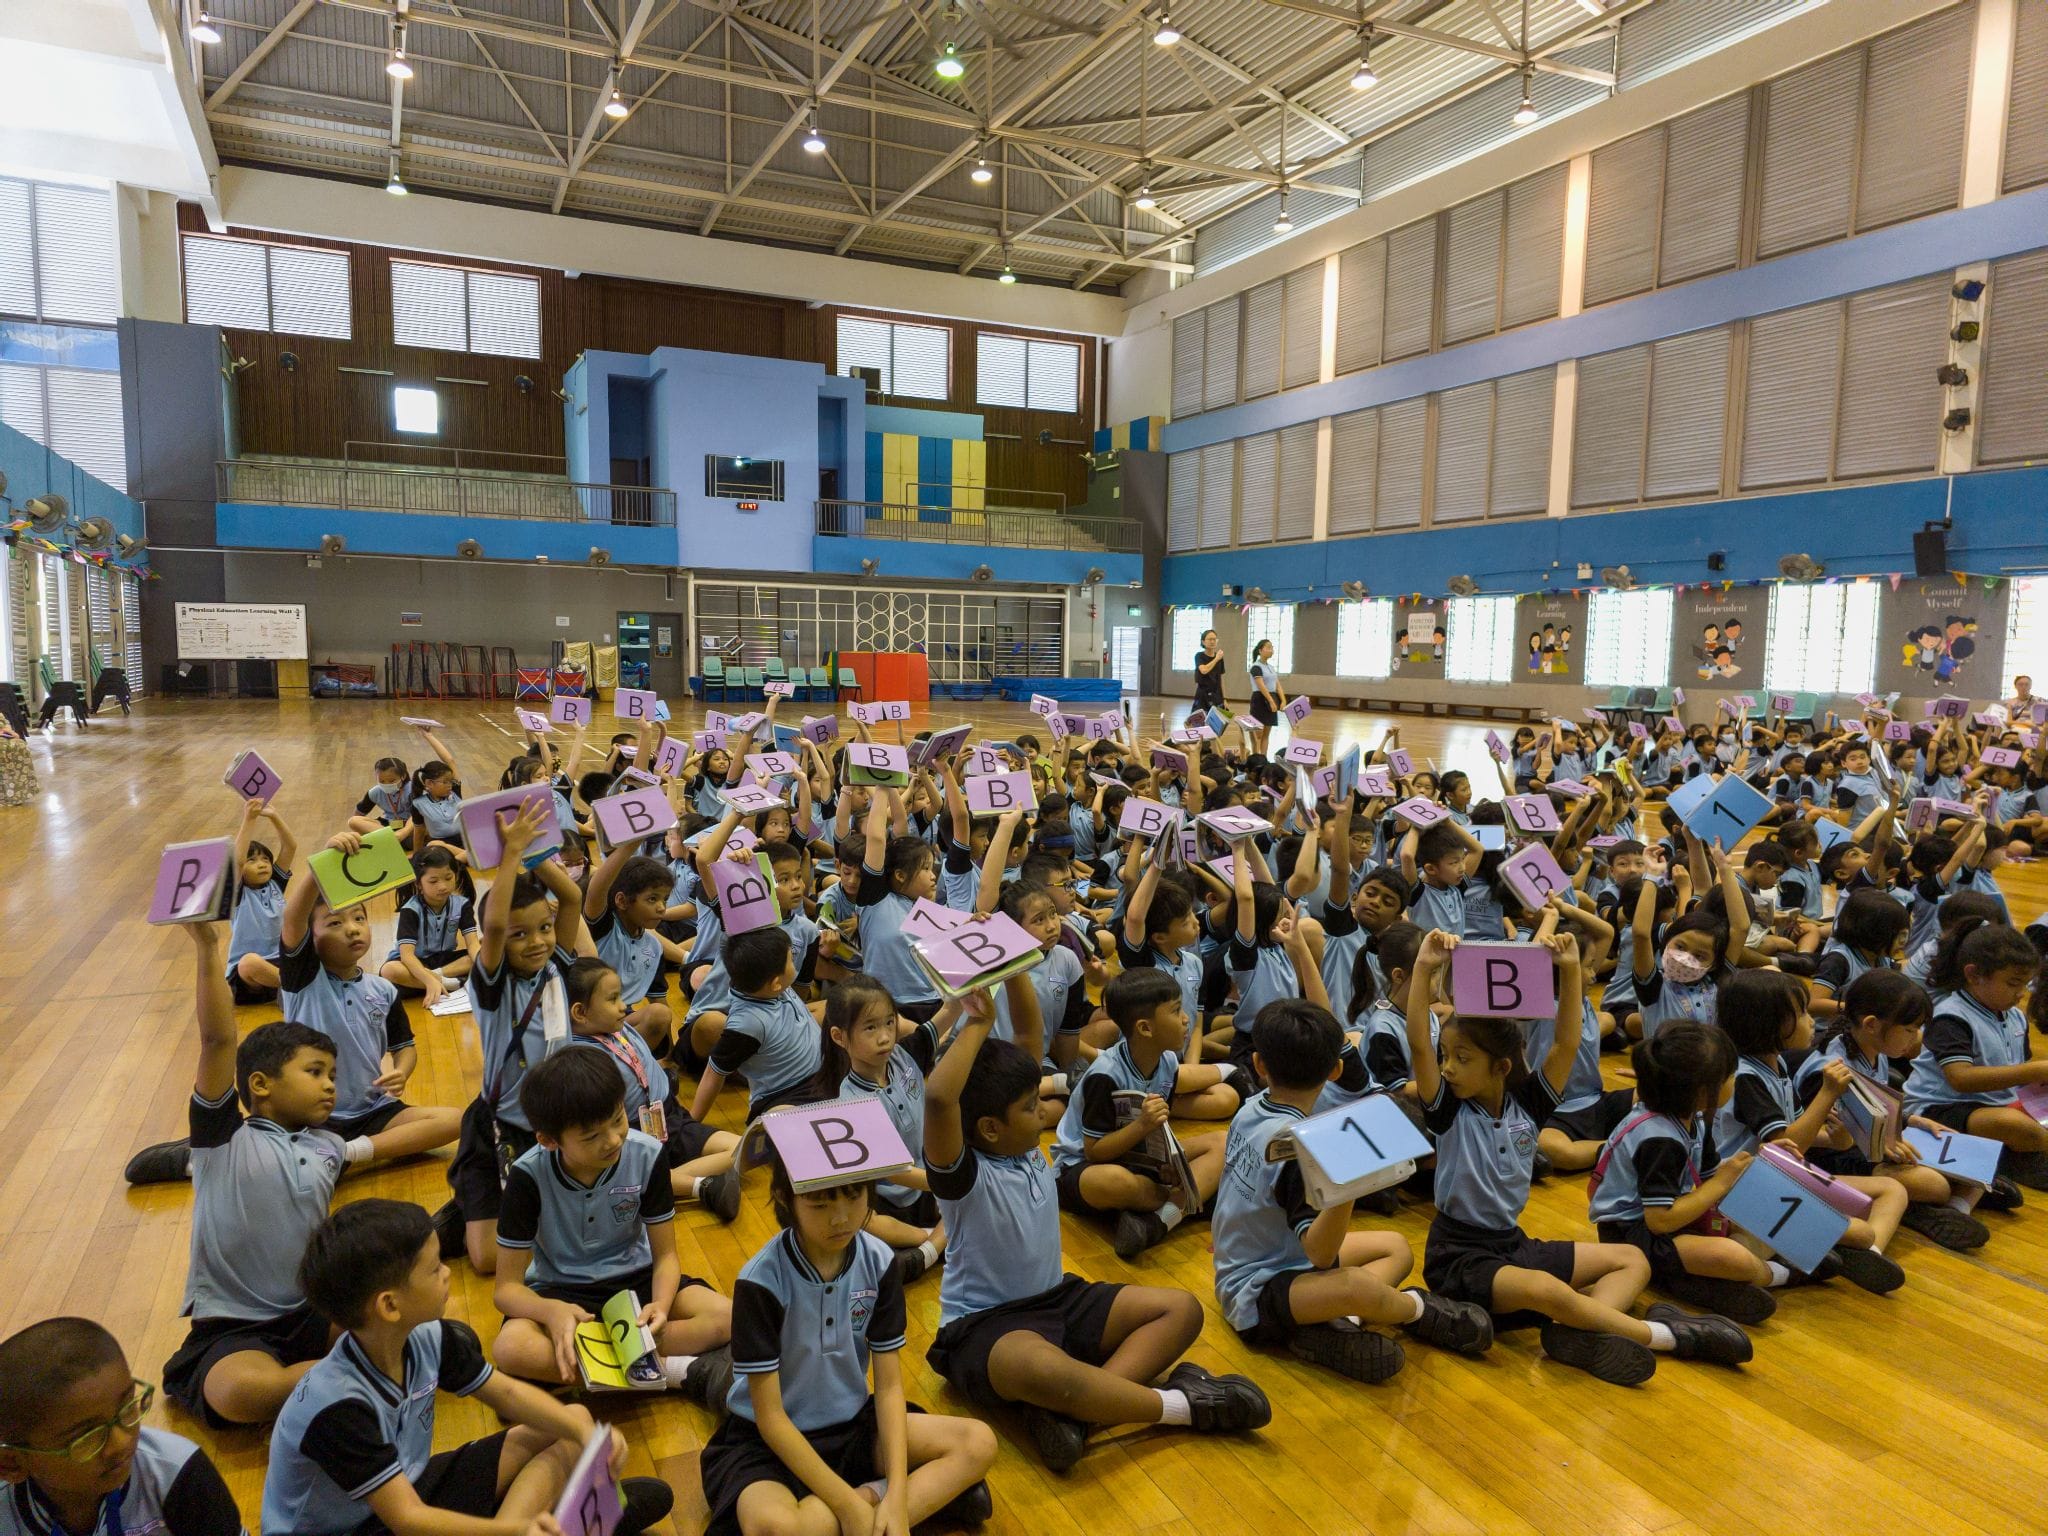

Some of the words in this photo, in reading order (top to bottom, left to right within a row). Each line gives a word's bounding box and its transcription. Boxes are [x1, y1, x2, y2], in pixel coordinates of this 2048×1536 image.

[1921, 584, 1968, 596] Commit
[1695, 604, 1747, 615] Independent
[1926, 598, 1963, 609] Myself
[1537, 610, 1567, 619] Learning
[774, 683, 784, 692] B
[564, 702, 578, 721] B
[629, 695, 644, 717] B
[891, 705, 902, 719] B
[1040, 700, 1050, 713] B
[1294, 704, 1305, 720] B
[1782, 699, 1789, 710] B
[1947, 702, 1959, 716] B
[857, 707, 868, 721] B
[1109, 714, 1119, 728] B
[528, 715, 543, 730] B
[716, 717, 726, 731] B
[1052, 719, 1064, 736] B
[1066, 719, 1076, 734] B
[1094, 723, 1103, 738] B
[816, 725, 830, 743] B
[1185, 729, 1201, 740] B
[1892, 725, 1903, 738] B
[705, 735, 717, 750] B
[868, 747, 891, 768] B
[1293, 746, 1318, 758] B
[1992, 752, 2007, 764] B
[763, 757, 786, 773] B
[981, 751, 996, 773] B
[1164, 754, 1178, 769] B
[1396, 755, 1409, 773] B
[243, 767, 267, 797] B
[1366, 778, 1383, 794] B
[733, 792, 765, 804] B
[988, 780, 1013, 808] B
[620, 800, 655, 834] B
[1139, 807, 1162, 832] B
[1408, 804, 1438, 821] B
[1523, 803, 1546, 829] B
[1713, 801, 1746, 827] 1
[1917, 805, 1931, 828] B
[341, 843, 388, 888] C
[170, 858, 201, 915] B
[1522, 861, 1553, 897] B
[727, 877, 767, 909] B
[951, 931, 1007, 968] B
[1485, 958, 1523, 1011] B
[809, 1117, 870, 1170] B
[1340, 1116, 1387, 1160] 1
[1937, 1135, 1957, 1165] 1
[1768, 1196, 1803, 1239] 1
